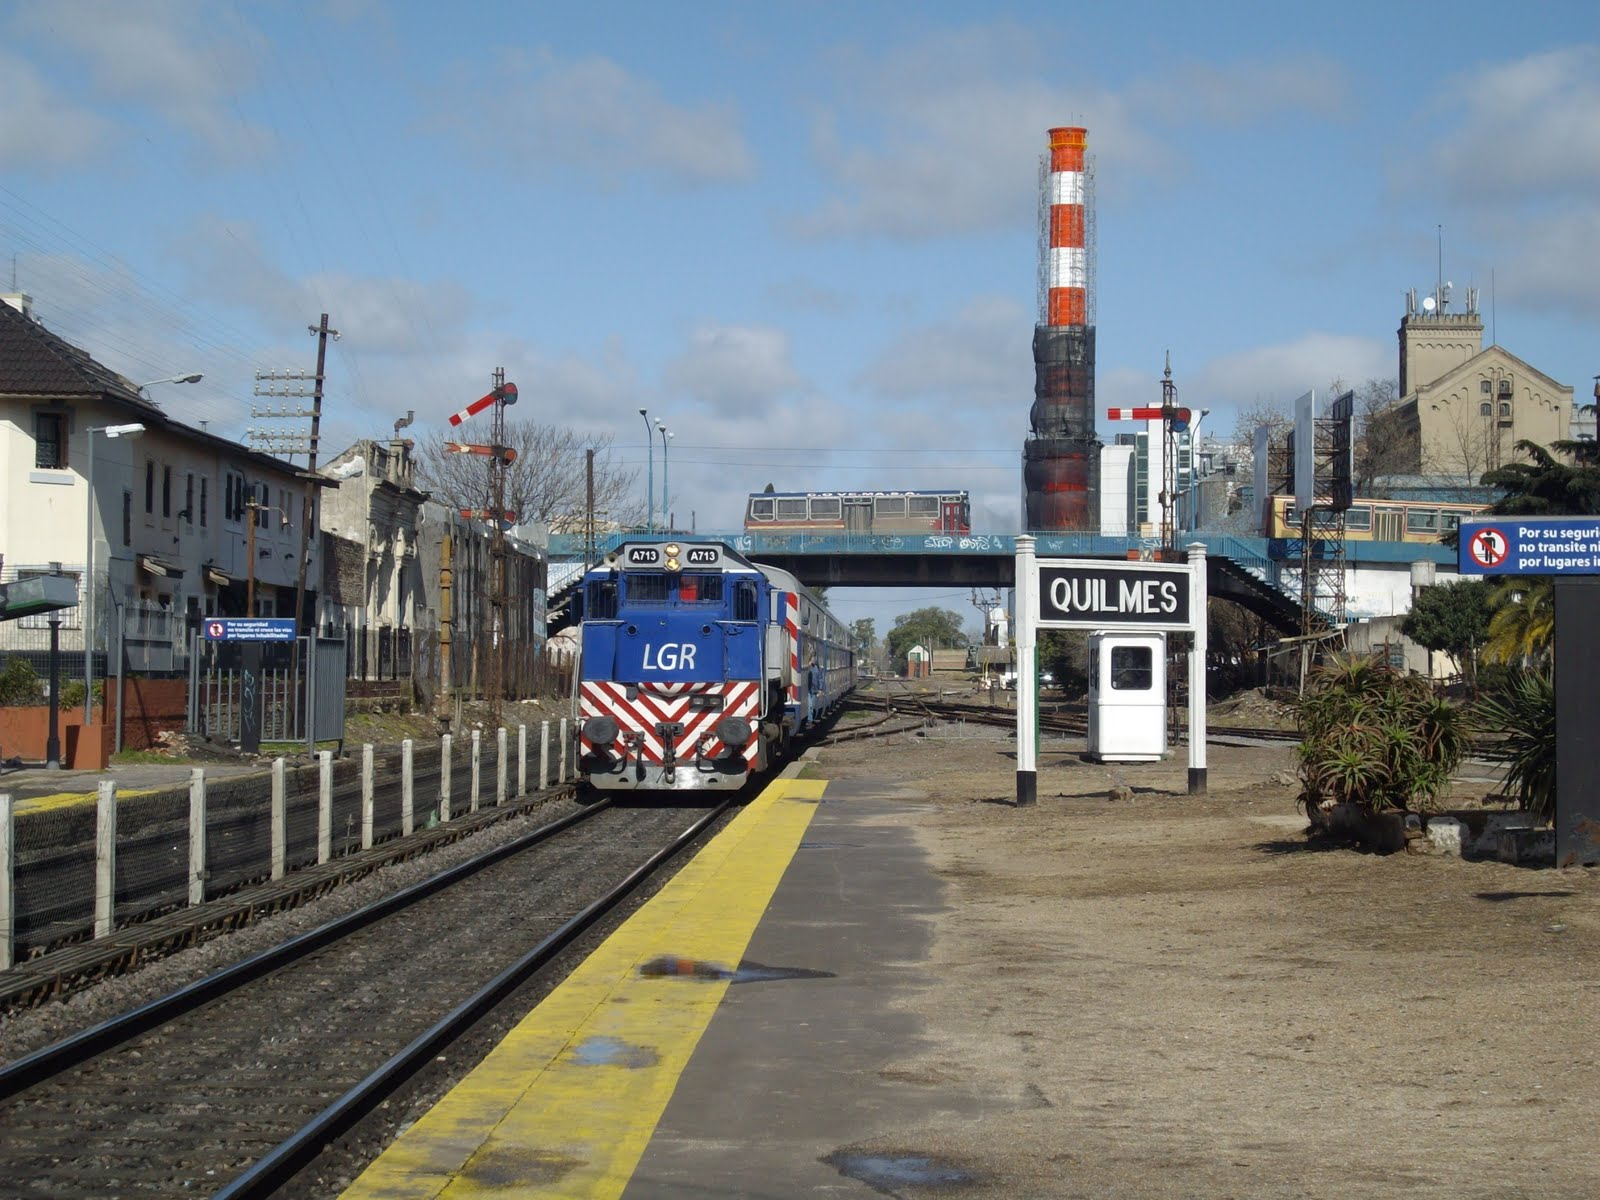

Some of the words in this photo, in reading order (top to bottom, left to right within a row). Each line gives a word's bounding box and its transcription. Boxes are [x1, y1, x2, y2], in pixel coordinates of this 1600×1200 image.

[1519, 527, 1541, 538] Por
[1543, 529, 1557, 538] su
[1560, 526, 1600, 541] seguri
[1519, 543, 1535, 552] no
[1538, 541, 1587, 552] transite
[632, 551, 657, 561] A713
[690, 551, 715, 561] A713
[1519, 558, 1541, 569] por
[1544, 555, 1591, 570] lugares
[1050, 577, 1178, 614] QUILMES
[642, 643, 697, 670] LGR
